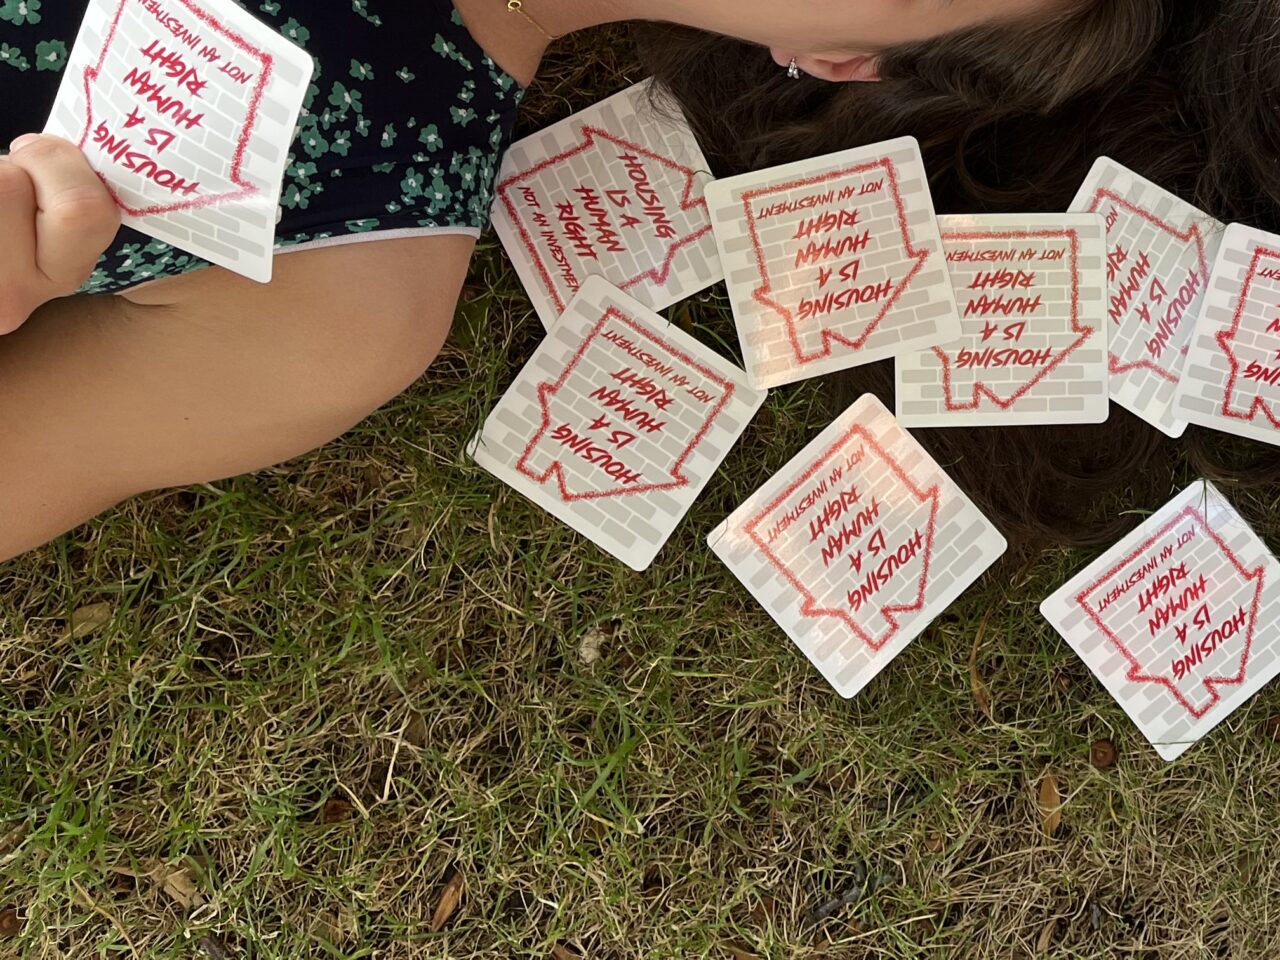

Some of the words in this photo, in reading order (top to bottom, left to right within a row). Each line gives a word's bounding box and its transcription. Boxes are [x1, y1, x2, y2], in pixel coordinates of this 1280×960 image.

[141, 40, 209, 98] RIGHT
[202, 46, 222, 63] AN
[220, 63, 254, 85] NOT
[123, 67, 204, 130] HUMAN
[124, 106, 146, 128] A
[144, 128, 177, 154] IS
[93, 120, 201, 196] HOUSING
[837, 184, 856, 200] AN
[857, 179, 884, 196] NOT
[756, 189, 835, 220] INVESTMENT
[793, 208, 859, 240] RIGHT
[793, 229, 871, 267] HUMAN
[815, 266, 833, 289] A
[837, 258, 861, 282] IS
[796, 278, 893, 320] HOUSING
[600, 329, 673, 377] INVESTMENT
[609, 366, 674, 410] RIGHT
[668, 373, 690, 388] AN
[685, 385, 714, 404] NOT
[587, 413, 612, 431] A
[588, 384, 666, 434] HUMAN
[550, 422, 642, 485] HOUSING
[606, 428, 637, 450] IS
[845, 445, 866, 471] NOT
[828, 465, 844, 485] AN
[767, 478, 829, 544] INVESTMENT
[808, 484, 861, 542] RIGHT
[820, 496, 880, 567] HUMAN
[865, 527, 887, 557] IS
[1176, 526, 1196, 549] NOT
[847, 549, 863, 574] A
[1158, 543, 1174, 562] AN
[846, 529, 923, 612] HOUSING
[1097, 555, 1159, 613] INVESTMENT
[1137, 561, 1189, 614] RIGHT
[1147, 573, 1207, 637] HUMAN
[1191, 602, 1212, 630] IS
[1170, 606, 1247, 680] HOUSING
[1173, 622, 1189, 645] A
